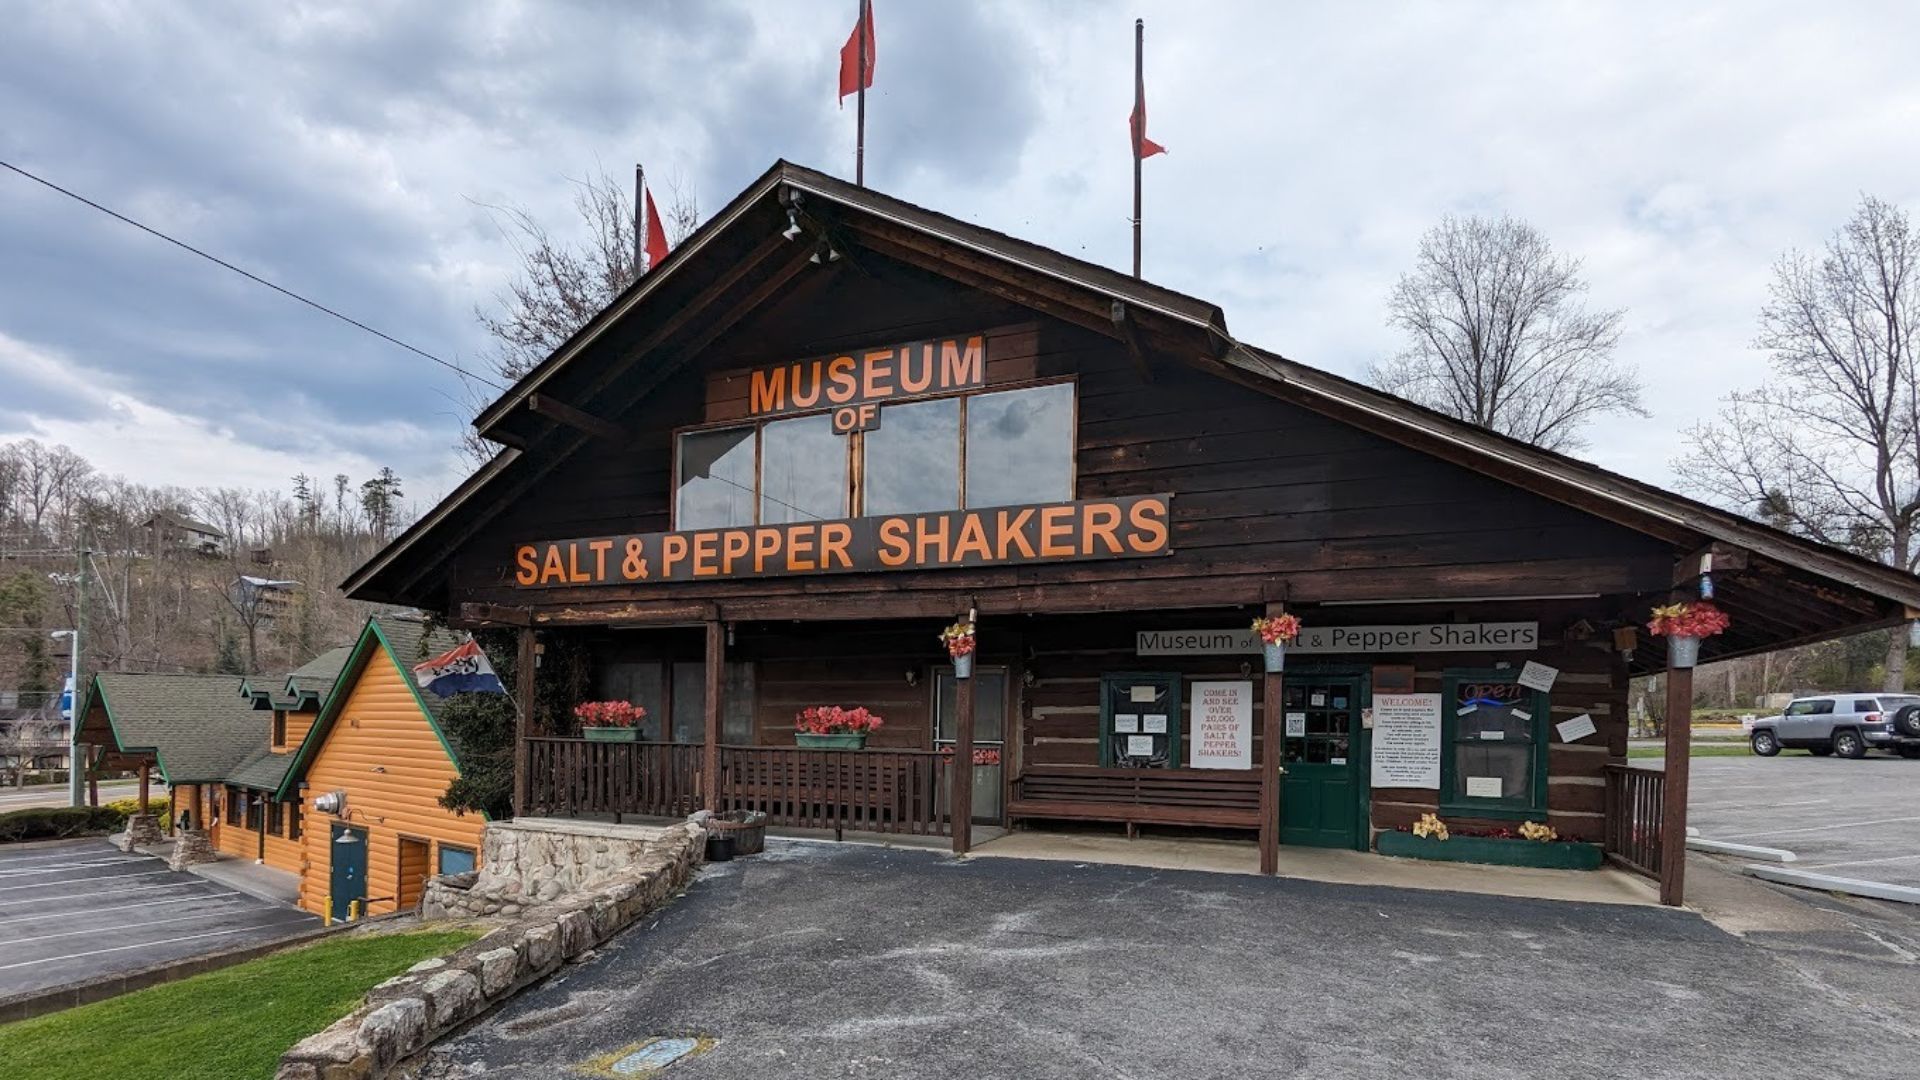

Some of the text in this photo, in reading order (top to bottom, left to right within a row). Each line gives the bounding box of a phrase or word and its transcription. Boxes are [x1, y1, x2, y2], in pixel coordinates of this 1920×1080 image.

[750, 336, 983, 414] MUSEUM
[834, 404, 877, 431] OF
[516, 499, 1167, 586] SALT & PEPPER SHAKERS
[1139, 633, 1233, 650] Museum
[1310, 634, 1323, 647] &
[1332, 628, 1421, 650] Pepper
[1429, 624, 1534, 646] Shakers
[1203, 689, 1238, 697] COME IN
[1202, 697, 1239, 706] AND SEE
[1208, 706, 1232, 714] OVER
[1204, 732, 1226, 740] SALT
[1203, 740, 1236, 749] PEPPER
